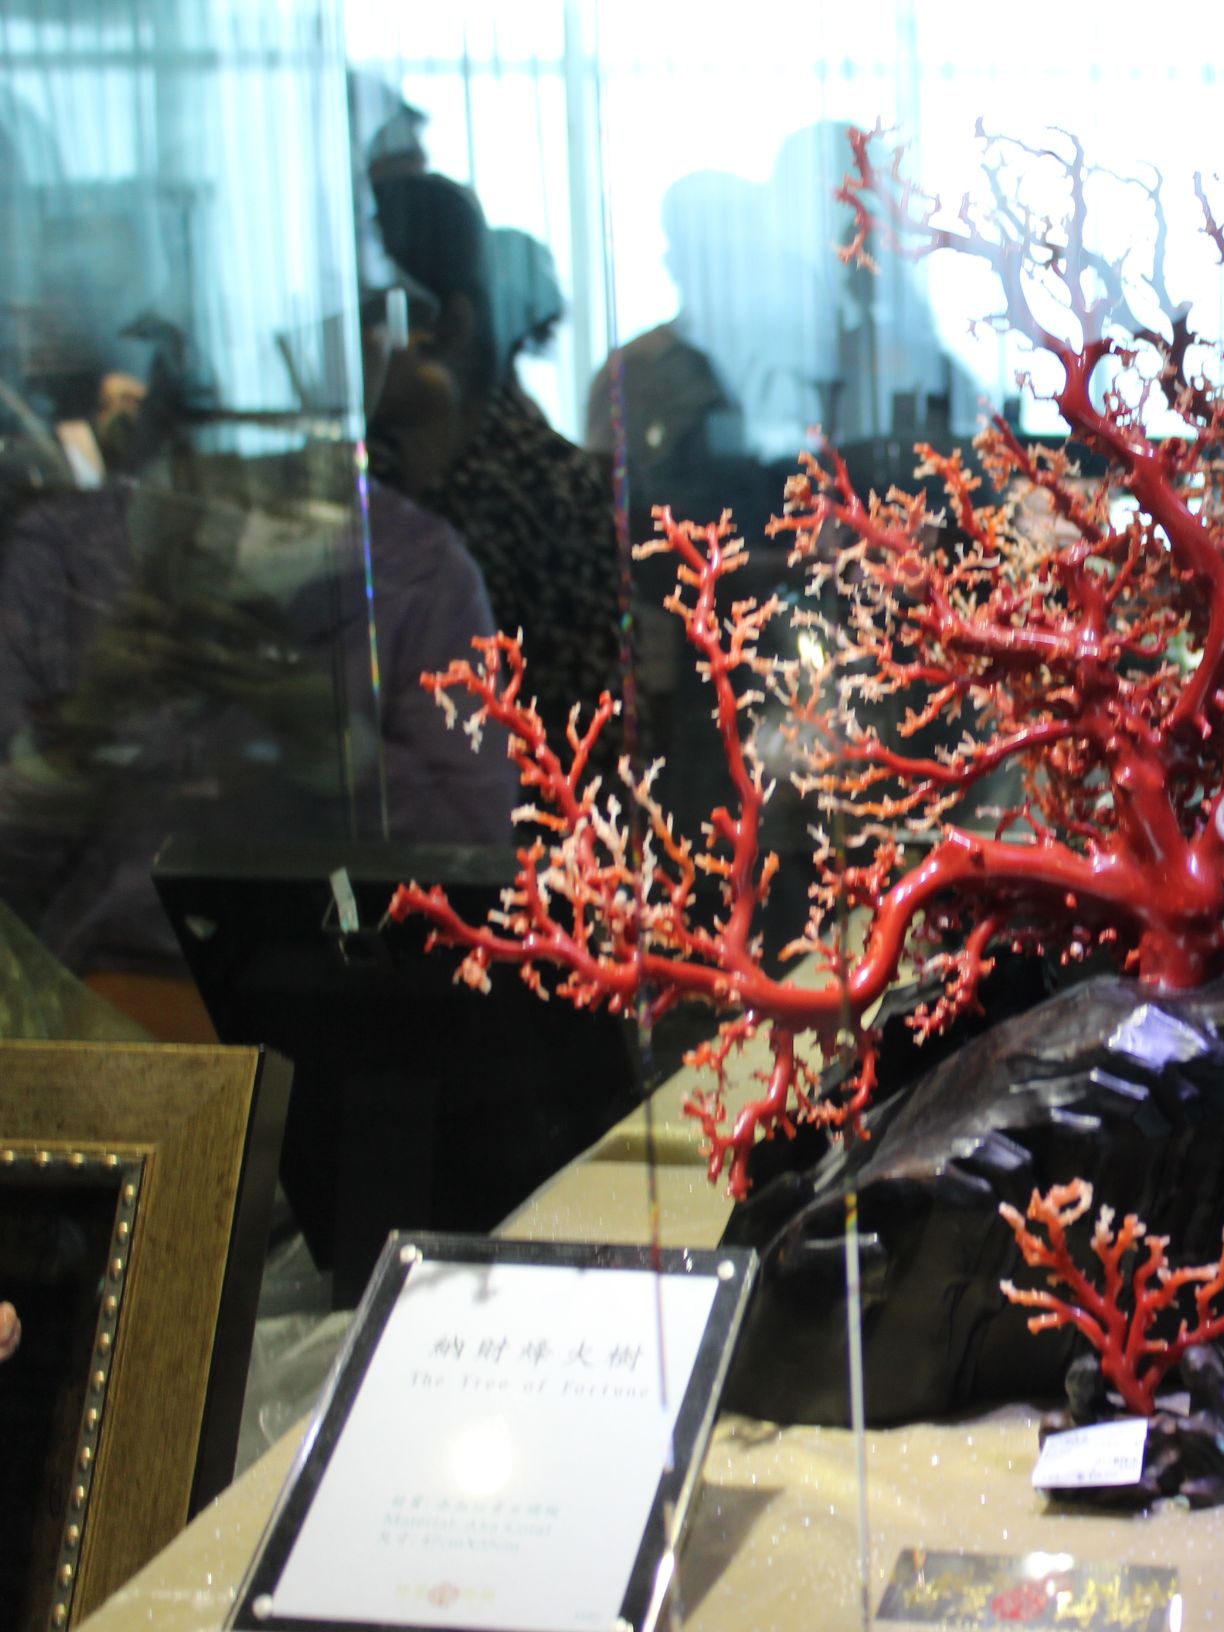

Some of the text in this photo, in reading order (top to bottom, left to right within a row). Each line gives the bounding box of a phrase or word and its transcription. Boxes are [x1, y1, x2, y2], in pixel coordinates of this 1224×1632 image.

[410, 1370, 650, 1399] The Tree of Fortune
